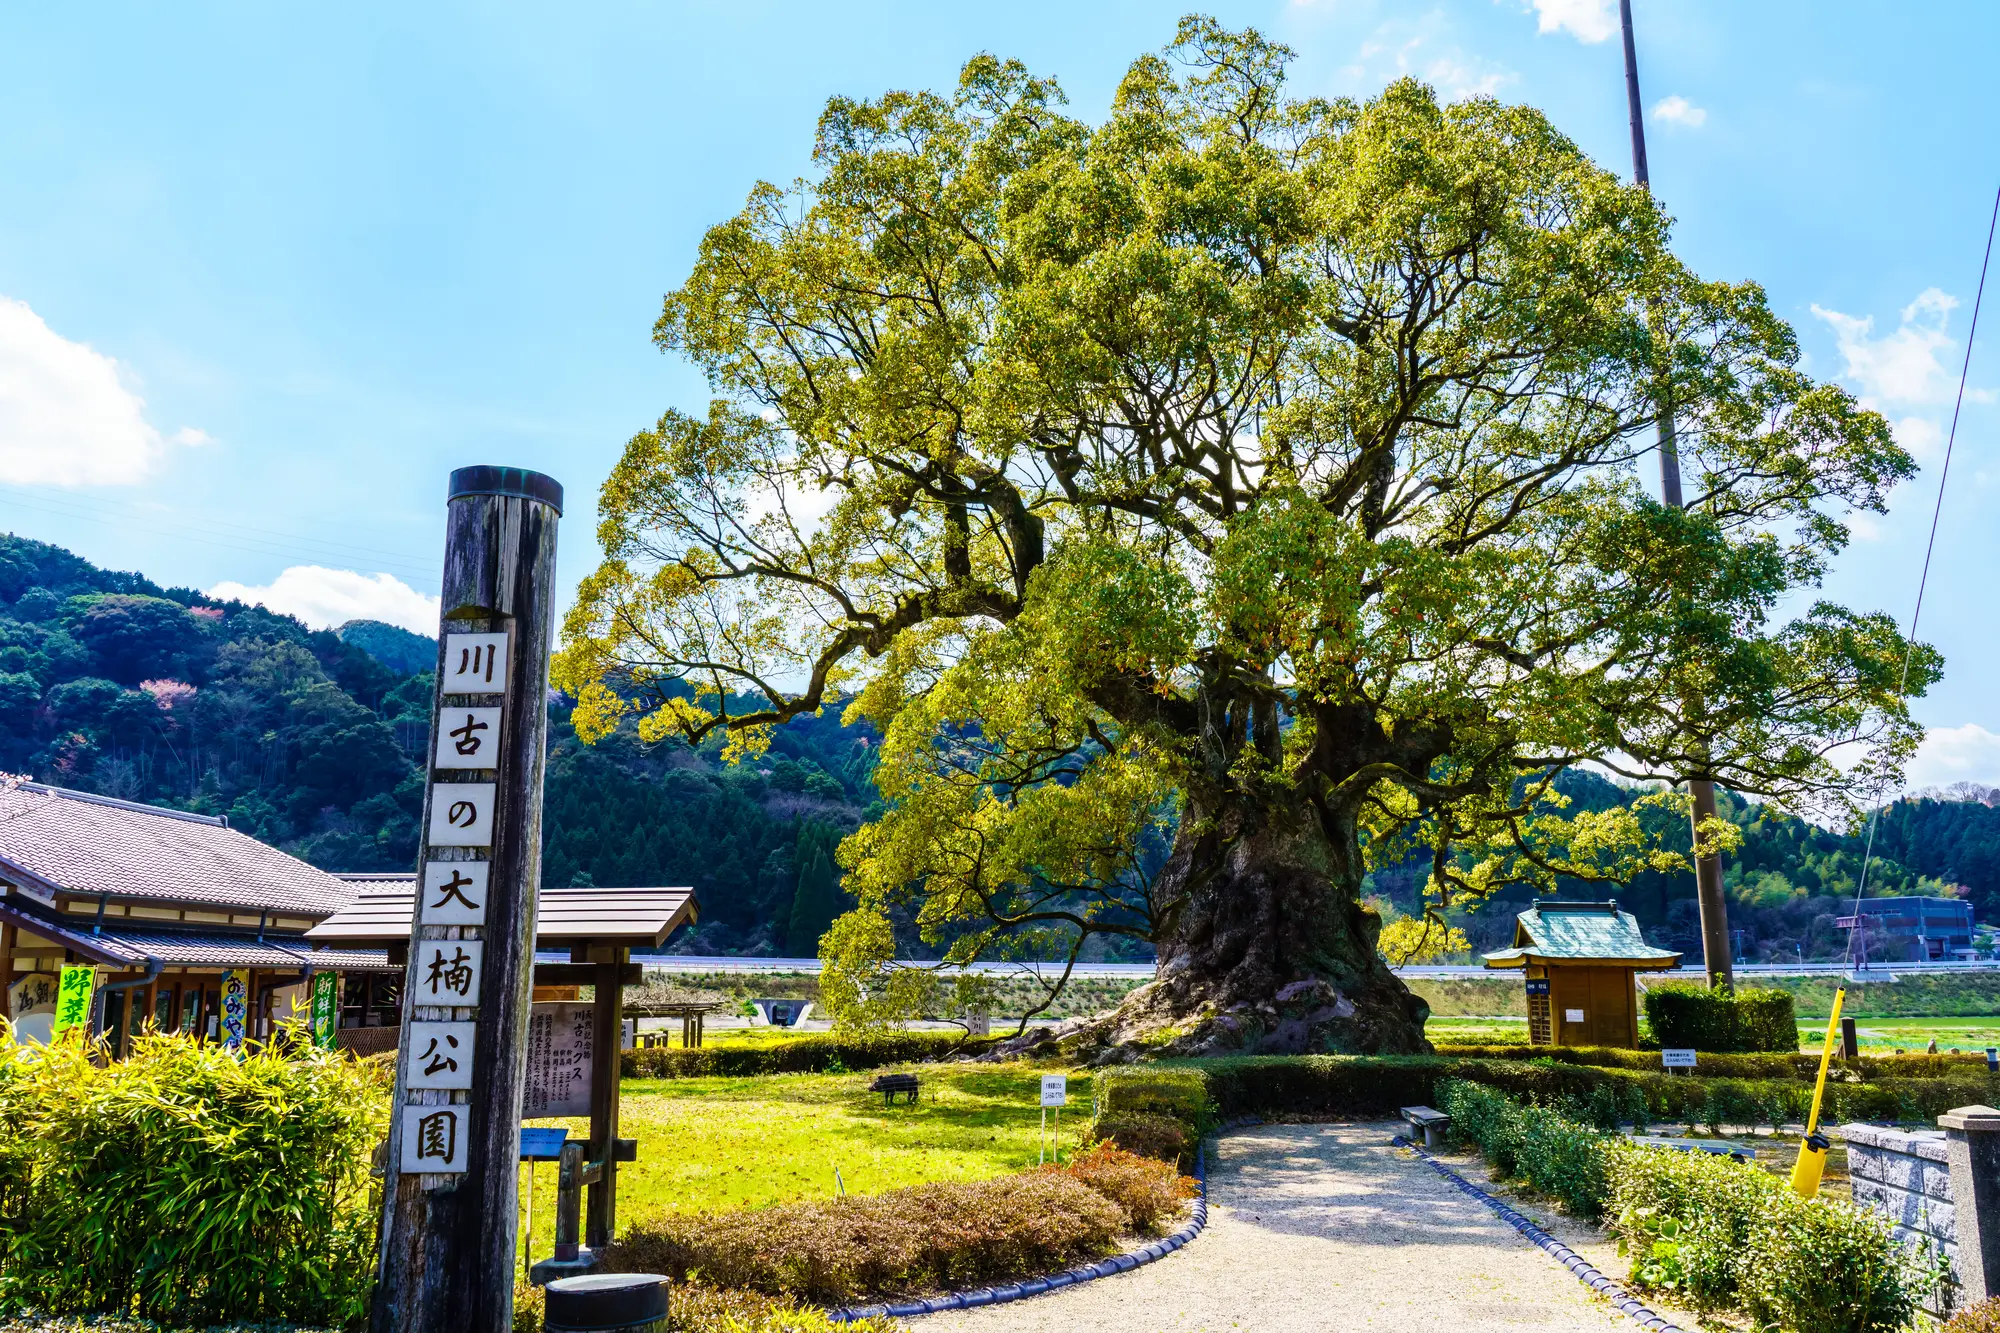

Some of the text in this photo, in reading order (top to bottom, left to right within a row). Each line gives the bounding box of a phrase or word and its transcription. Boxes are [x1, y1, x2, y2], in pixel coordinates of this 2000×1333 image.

[416, 643, 495, 1164] 川古の大楠公園
[60, 968, 92, 1024] 野菜
[572, 1009, 585, 1080] 川古のクス
[583, 1009, 593, 1059] 天然記念物
